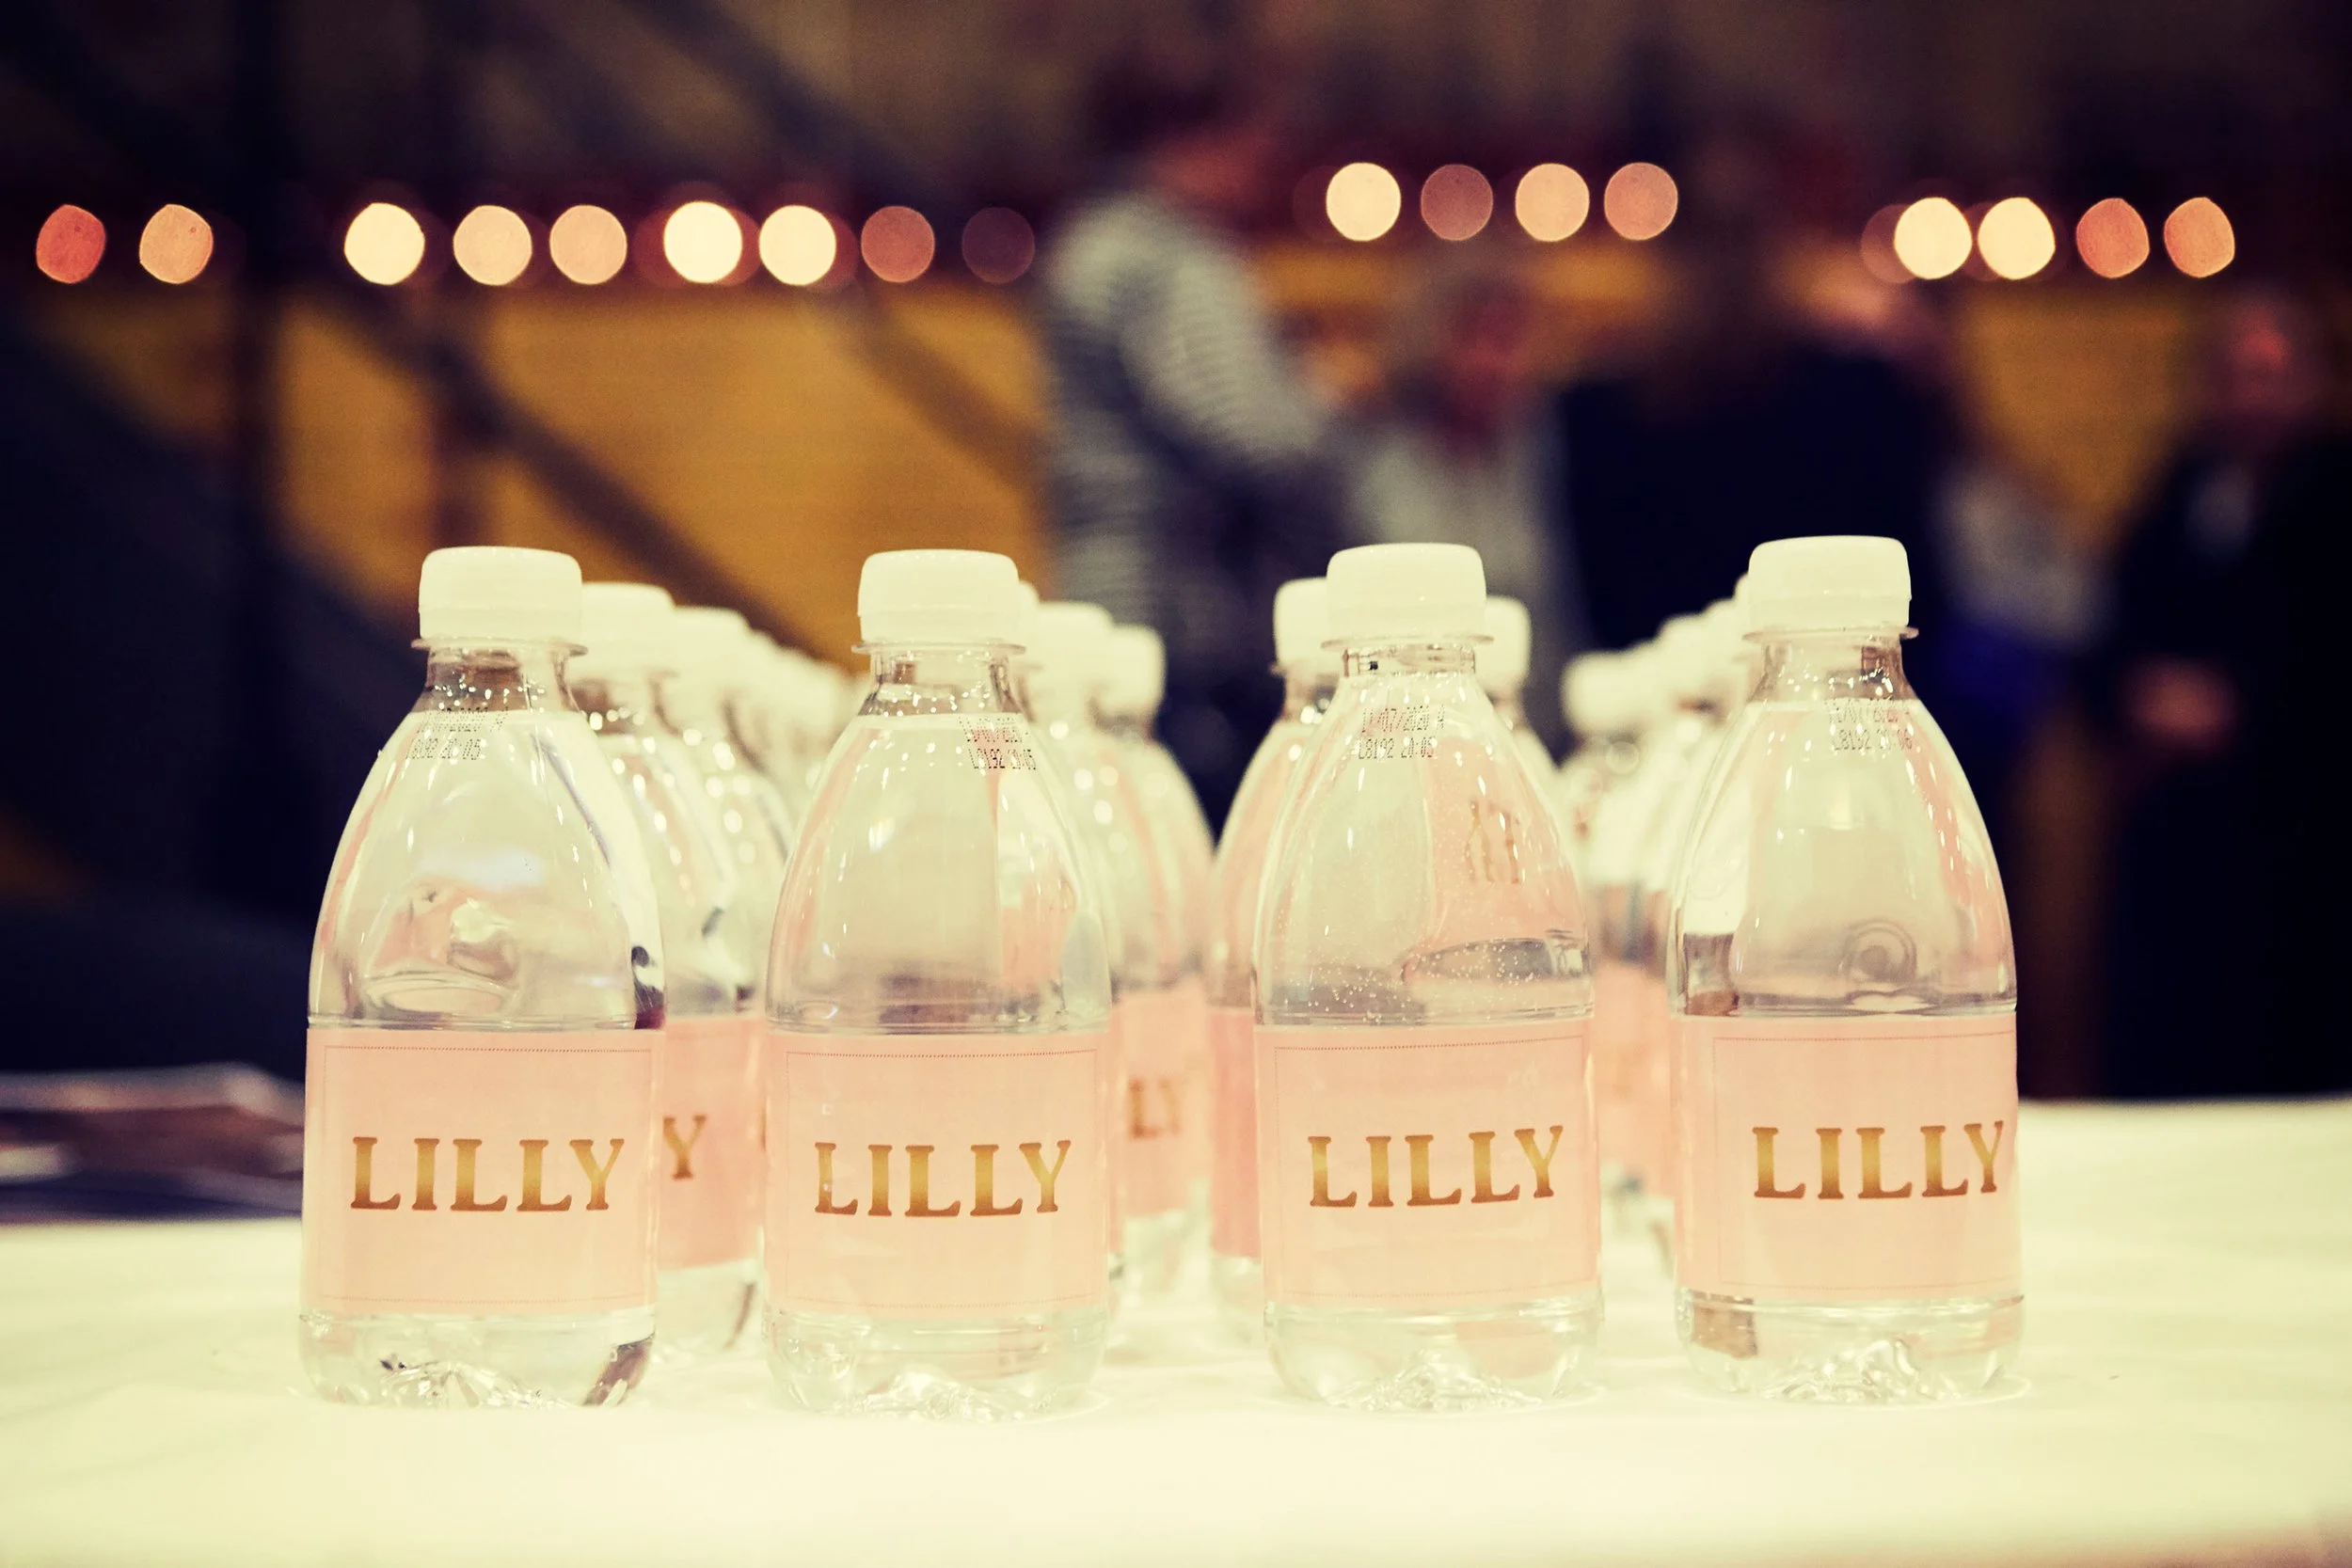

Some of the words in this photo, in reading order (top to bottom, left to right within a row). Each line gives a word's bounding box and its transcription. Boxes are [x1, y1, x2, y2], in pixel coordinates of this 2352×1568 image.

[351, 1135, 625, 1212] LILLY
[815, 1139, 1072, 1217] LILLY
[1308, 1125, 1564, 1208] LILLY
[1752, 1119, 2004, 1200] LILLY
